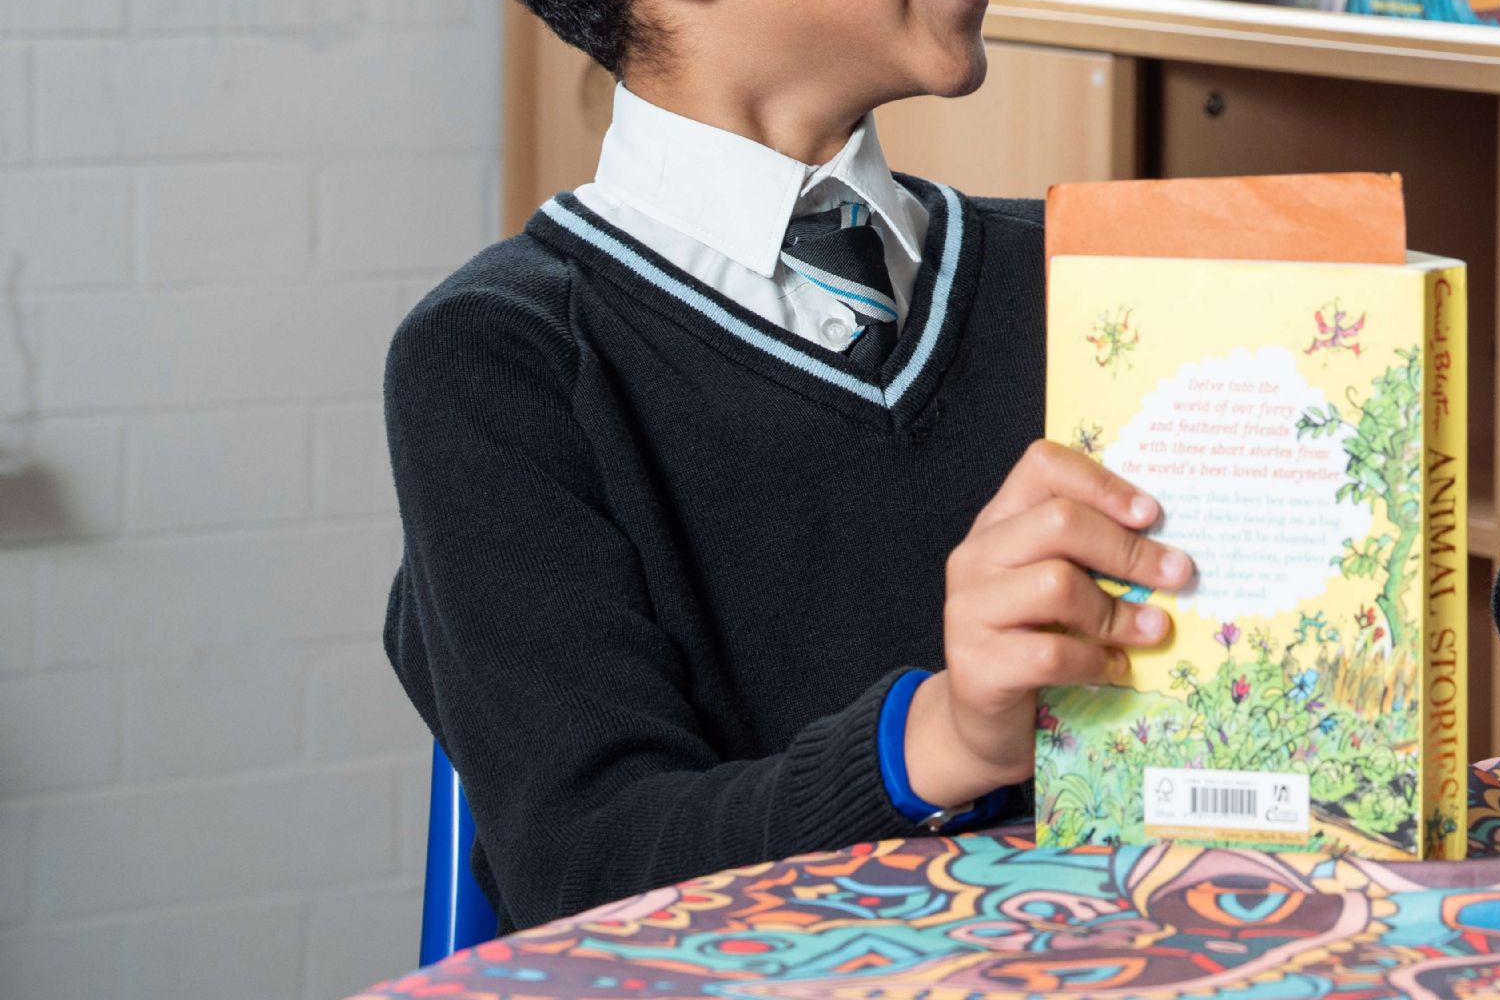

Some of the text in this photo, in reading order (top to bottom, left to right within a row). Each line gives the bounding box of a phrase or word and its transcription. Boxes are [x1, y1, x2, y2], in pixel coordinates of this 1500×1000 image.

[1188, 379, 1280, 393] Delve into the
[1173, 400, 1295, 419] world of our furry
[1149, 420, 1290, 438] and feathered friends
[1138, 440, 1330, 462] with these short stories from
[1121, 460, 1141, 473] the
[1147, 461, 1195, 476] world's
[1272, 465, 1341, 482] storyteller
[1428, 448, 1457, 616] ANIMAL
[1429, 628, 1459, 801] STORIES
